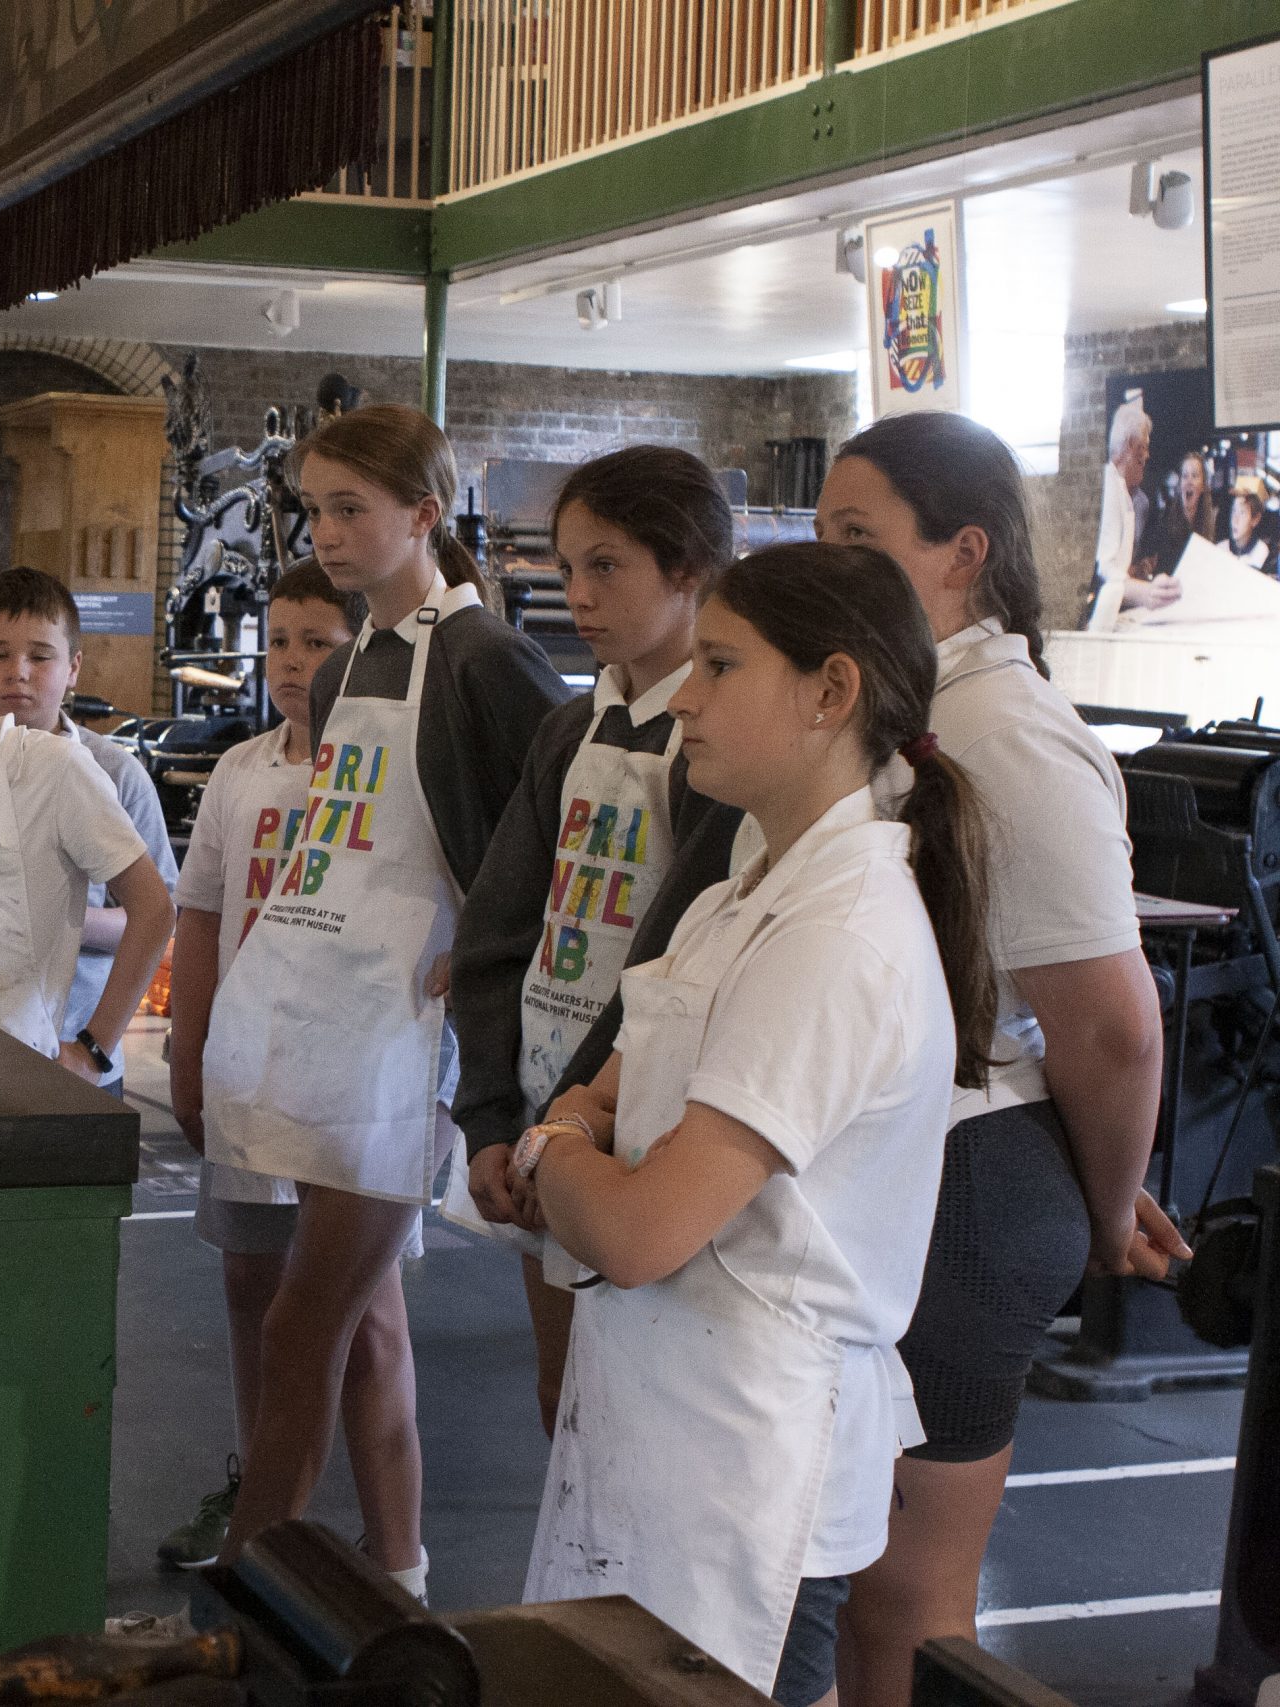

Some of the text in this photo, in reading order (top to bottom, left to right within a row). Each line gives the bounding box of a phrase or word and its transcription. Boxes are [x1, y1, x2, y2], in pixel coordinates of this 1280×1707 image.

[902, 271, 925, 292] NOW
[907, 312, 927, 330] that
[310, 743, 391, 794] PRI
[280, 848, 332, 897] AB
[263, 913, 290, 925] NATIONAL
[306, 920, 342, 934] MUSEUM
[317, 909, 329, 919] AT
[330, 912, 347, 923] THE
[539, 921, 589, 983] AB
[524, 995, 598, 1024] NATIONAL PRINT MUSE
[551, 991, 582, 1007] MAKERS
[582, 998, 595, 1010] AT
